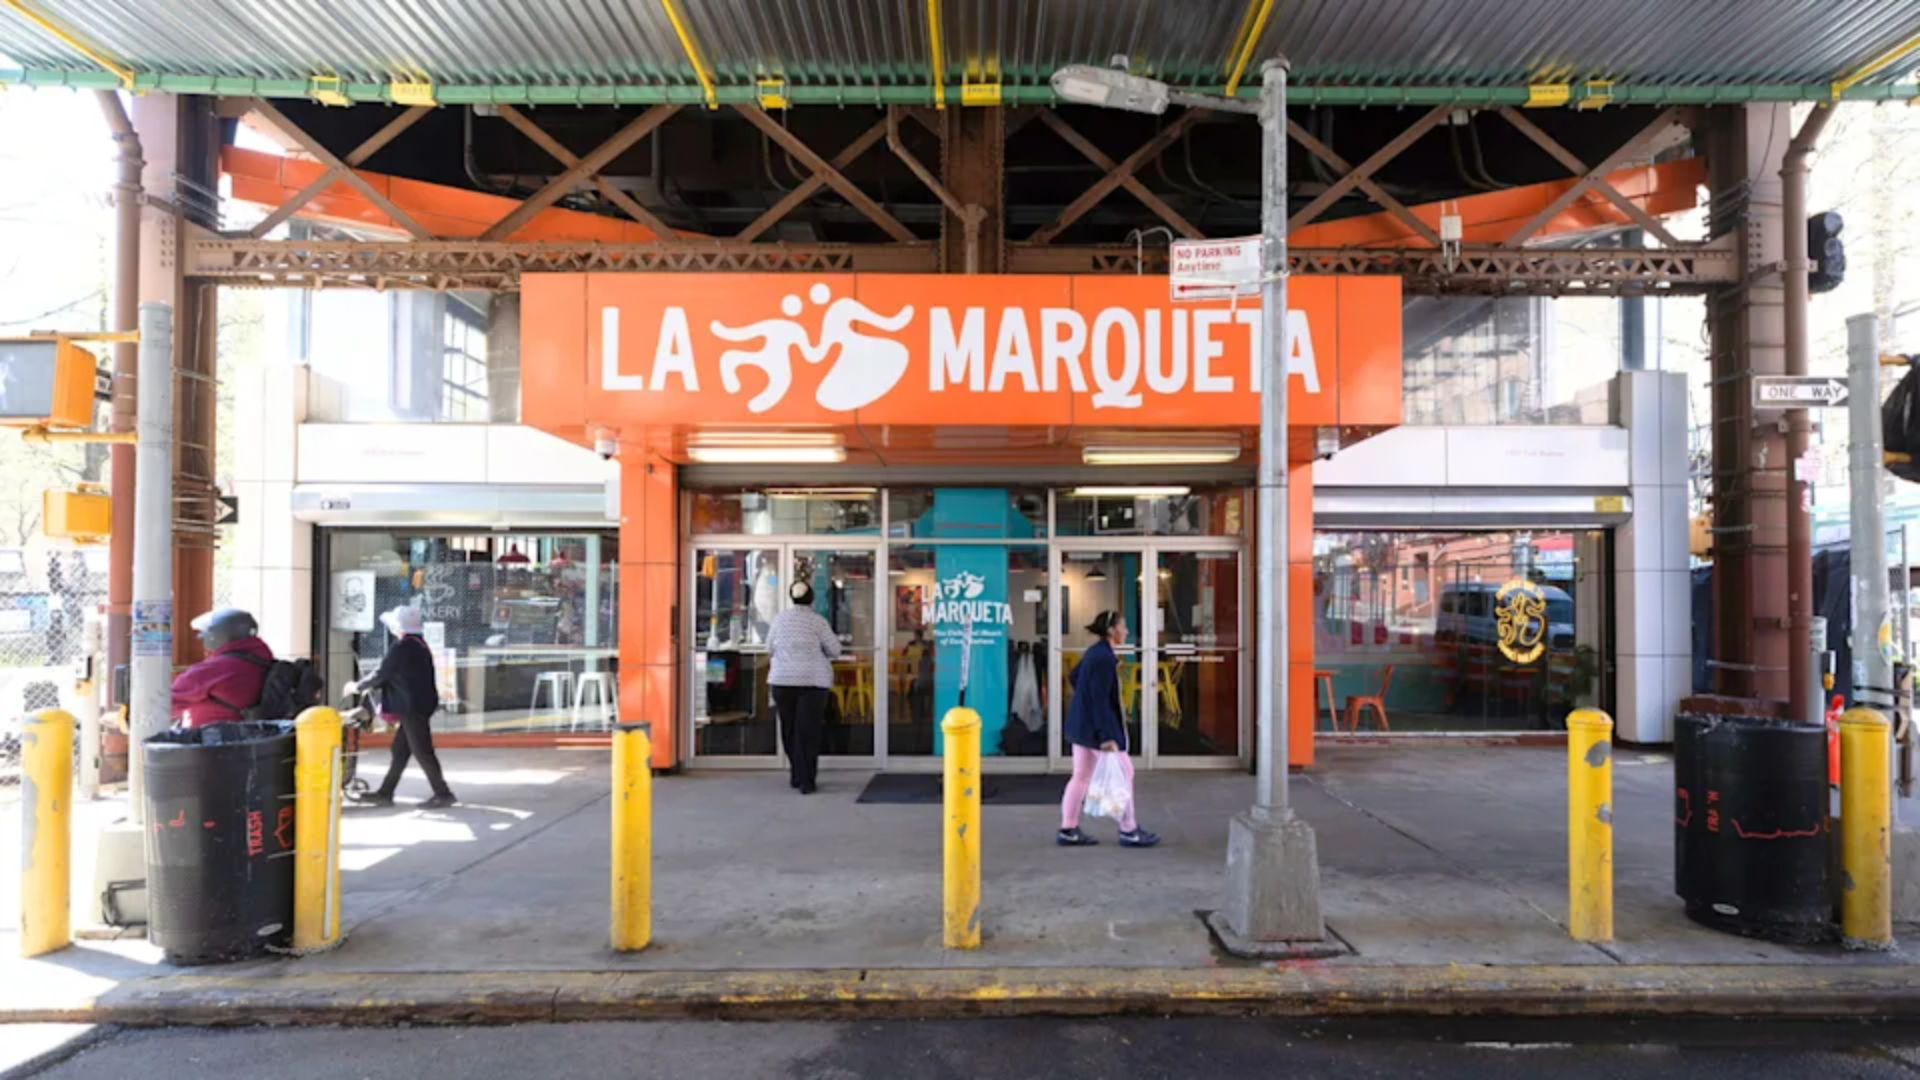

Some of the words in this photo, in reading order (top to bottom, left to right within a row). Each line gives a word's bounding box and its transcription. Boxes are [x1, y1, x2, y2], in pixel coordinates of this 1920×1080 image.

[1177, 249, 1192, 258] NO
[1195, 246, 1241, 257] PARKING
[1177, 262, 1222, 273] Anytime
[601, 307, 699, 391] LA
[929, 308, 1320, 409] MARQUETA
[1768, 386, 1798, 399] ONE
[1811, 386, 1841, 398] WAY
[922, 582, 943, 603] LA
[419, 605, 462, 619] AKERY
[921, 600, 1014, 625] MARQUETA
[1706, 790, 1719, 833] TRAH
[245, 810, 263, 857] TRASH
